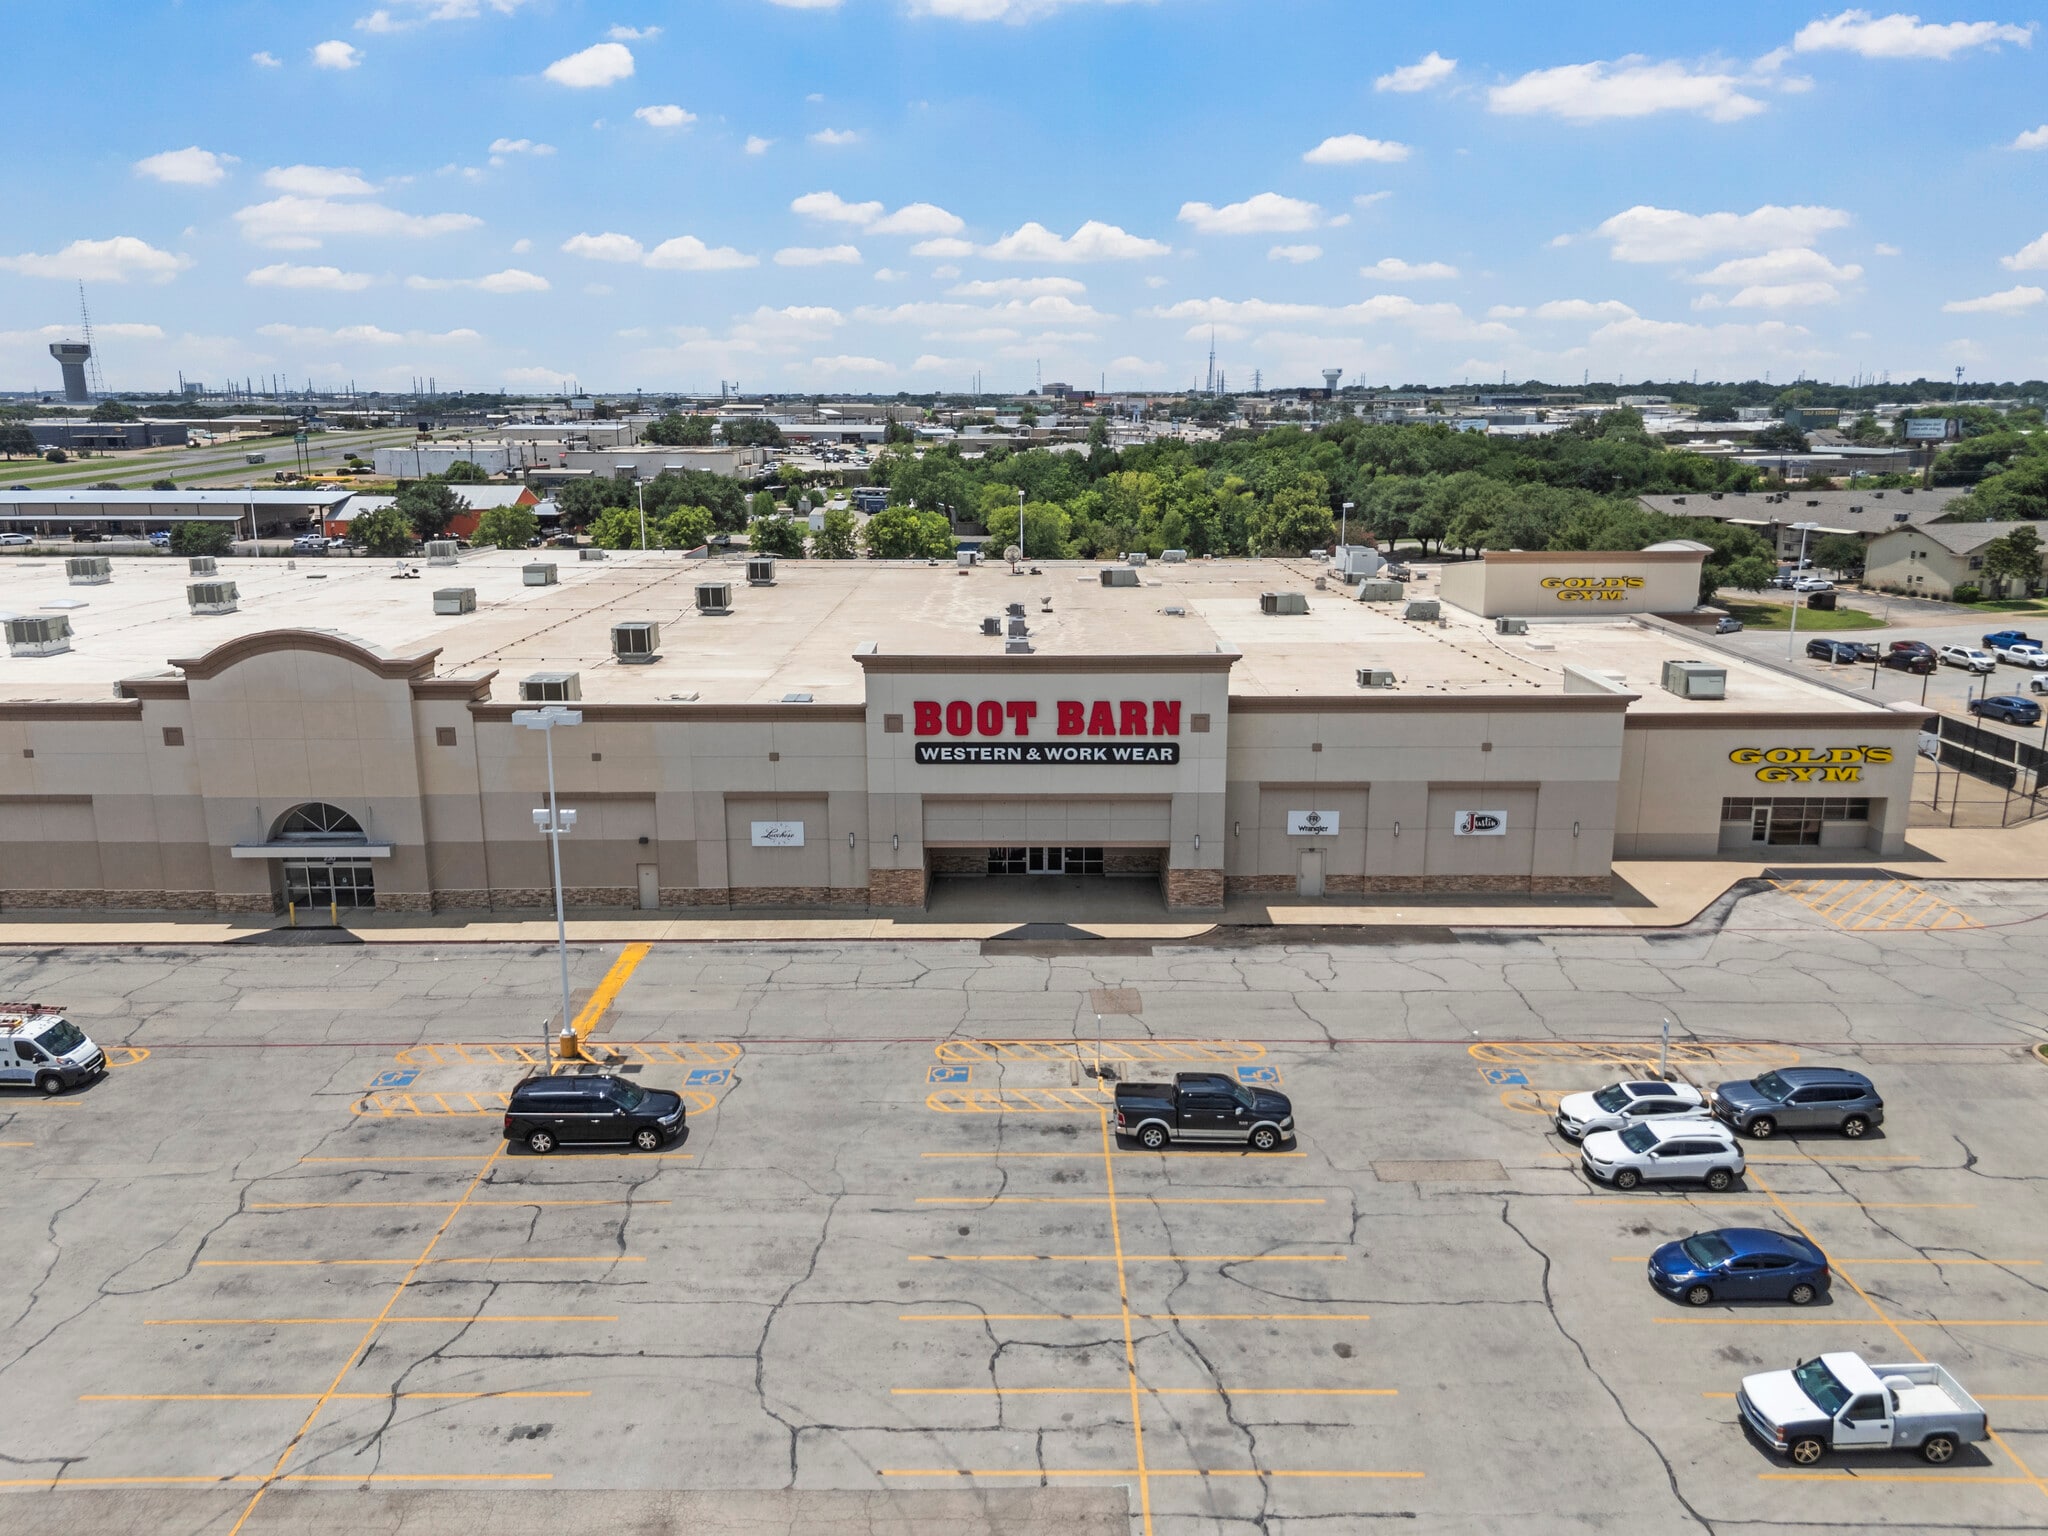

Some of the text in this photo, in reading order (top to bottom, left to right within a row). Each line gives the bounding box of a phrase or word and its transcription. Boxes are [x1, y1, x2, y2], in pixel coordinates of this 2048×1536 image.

[1541, 576, 1645, 589] GOLD'S
[913, 700, 1182, 736] BOOT BARN
[920, 747, 1174, 761] WESTERN & WORK WEAR
[1728, 745, 1895, 765] GOLD'S
[1755, 766, 1863, 783] GYM
[1297, 825, 1329, 835] Wrangler
[1461, 812, 1499, 834] Justin
